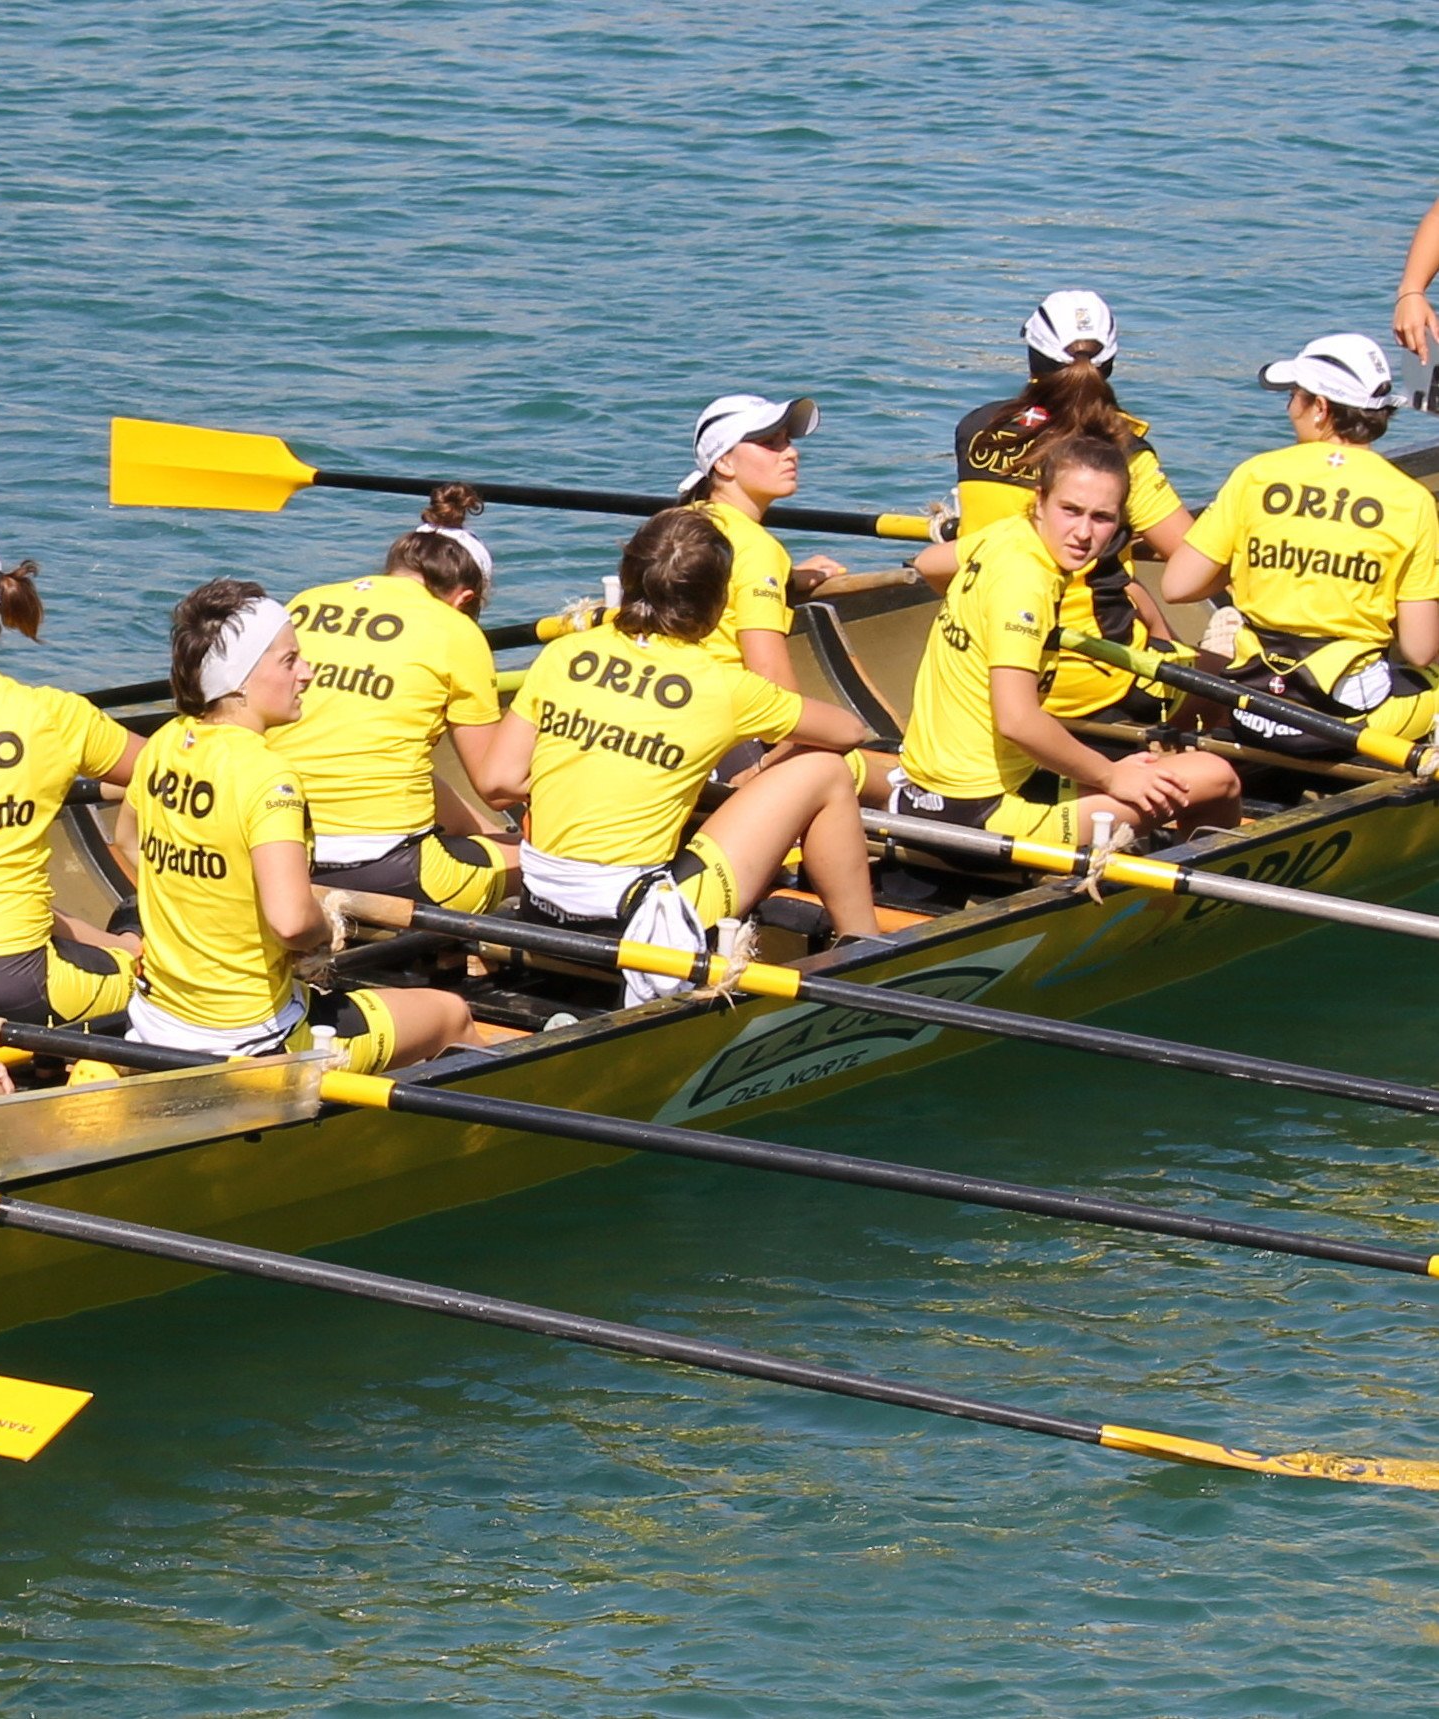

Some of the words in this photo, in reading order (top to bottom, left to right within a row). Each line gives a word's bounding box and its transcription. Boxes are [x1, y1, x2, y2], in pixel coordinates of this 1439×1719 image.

[1248, 536, 1381, 585] Babyauto
[539, 700, 685, 771] Babyauto
[725, 1083, 773, 1107] DEL
[779, 1049, 870, 1088] NORTE
